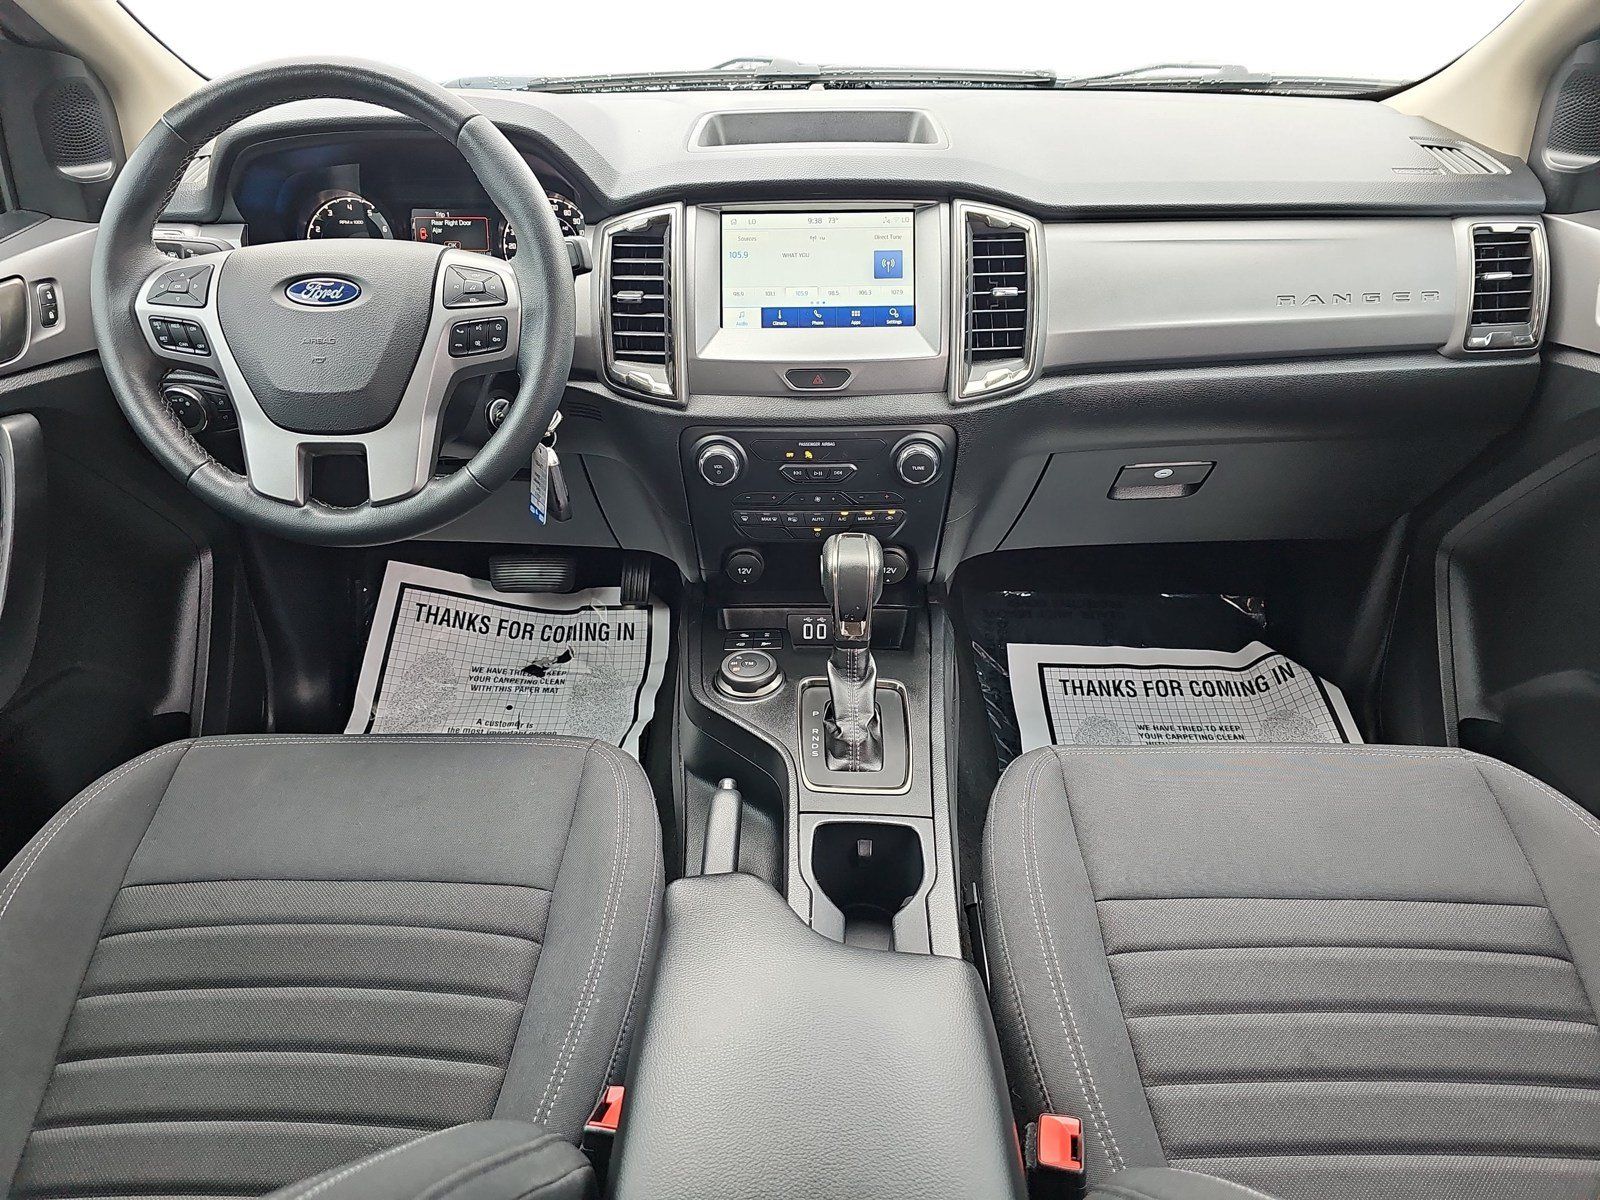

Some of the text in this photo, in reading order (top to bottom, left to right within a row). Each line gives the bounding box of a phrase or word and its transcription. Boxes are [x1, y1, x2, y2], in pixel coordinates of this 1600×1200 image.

[302, 282, 344, 299] Ford
[1276, 291, 1440, 306] RANGER
[415, 602, 492, 635] THANKS
[497, 618, 534, 640] FOR
[617, 622, 634, 640] IN
[494, 676, 538, 685] CARPETING
[1059, 662, 1296, 698] THANKS FOR COMING IN
